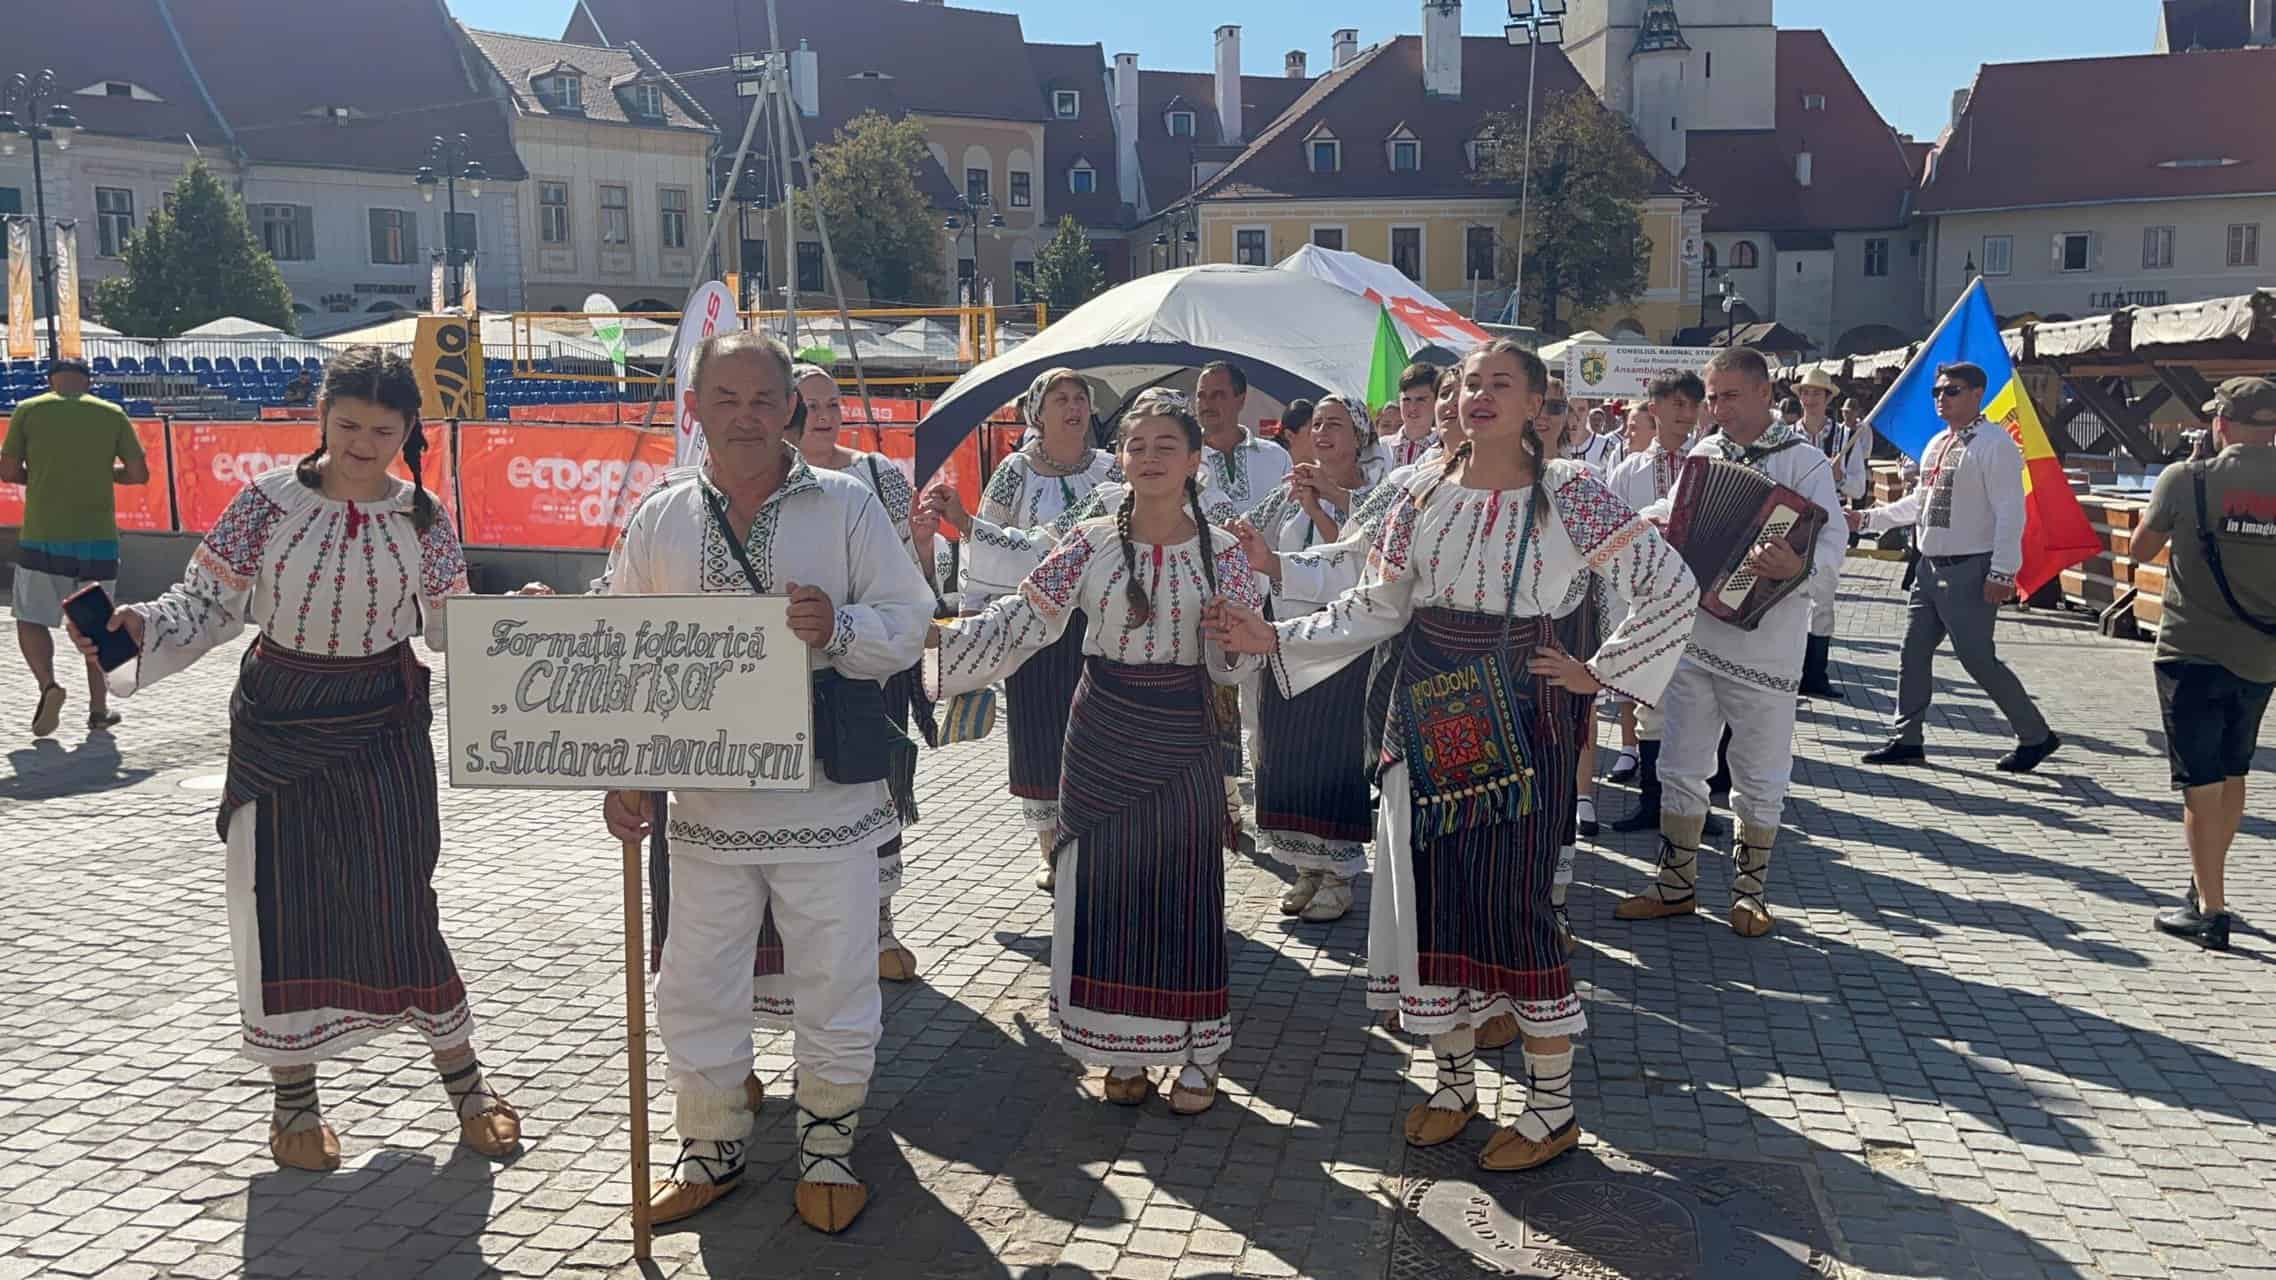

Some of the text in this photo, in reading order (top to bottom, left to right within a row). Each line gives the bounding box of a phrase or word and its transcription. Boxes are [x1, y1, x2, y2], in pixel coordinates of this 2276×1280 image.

[486, 618, 767, 664] Formația folclorică
[1412, 664, 1481, 704] MOLDOVA
